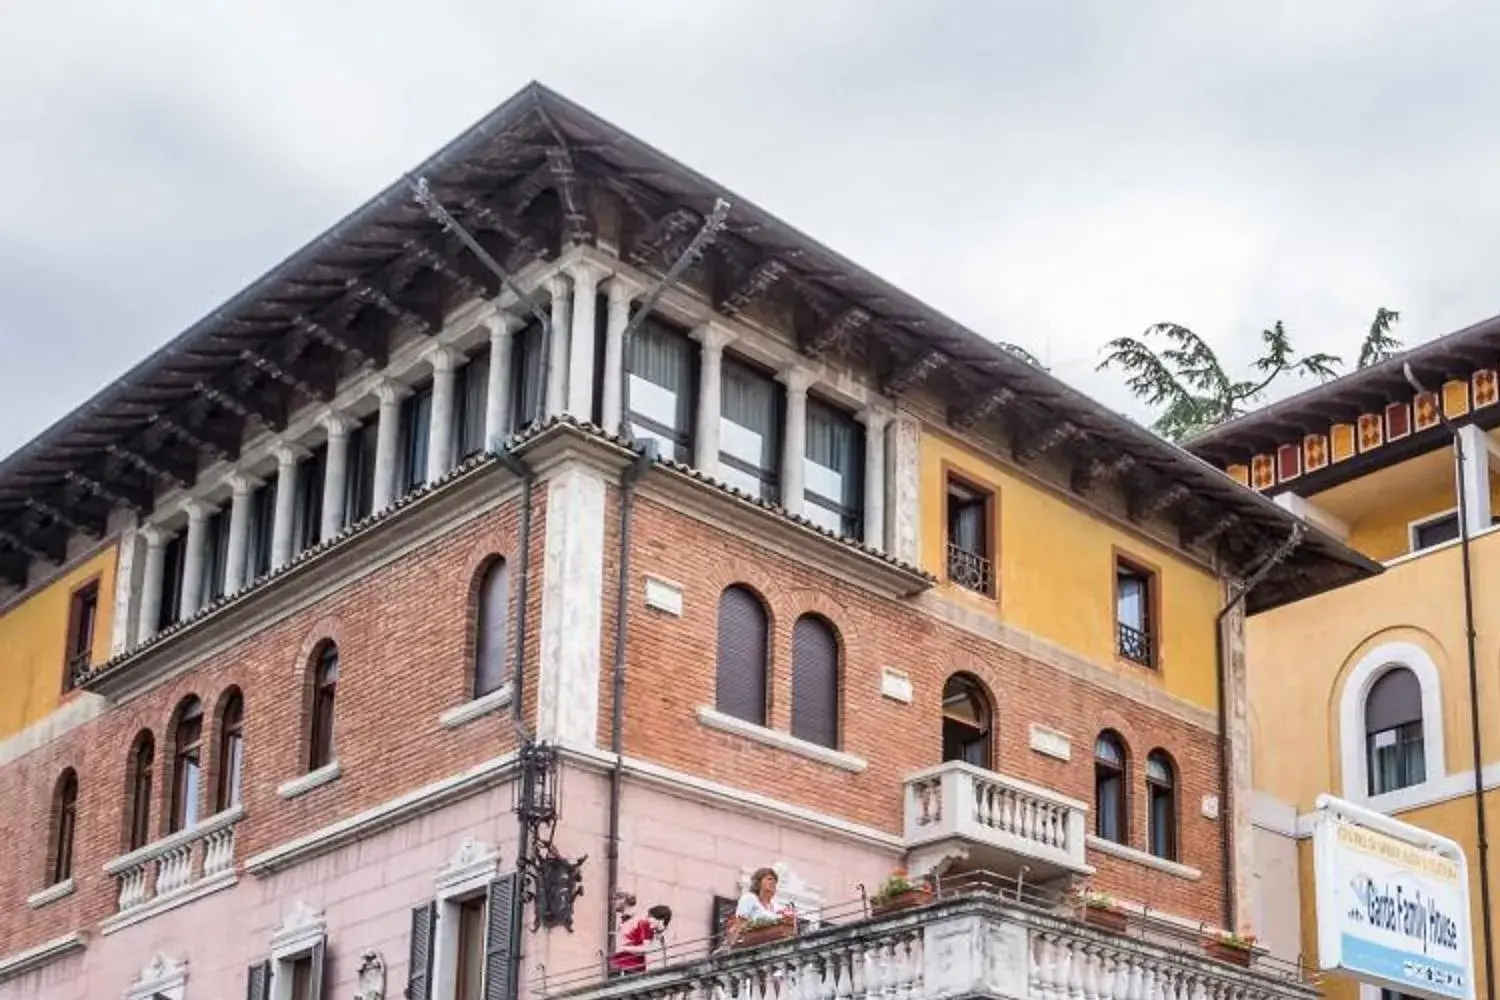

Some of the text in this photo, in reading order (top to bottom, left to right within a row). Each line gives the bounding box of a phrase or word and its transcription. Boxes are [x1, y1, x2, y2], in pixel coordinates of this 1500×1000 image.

[1367, 878, 1457, 953] Garda Family House
